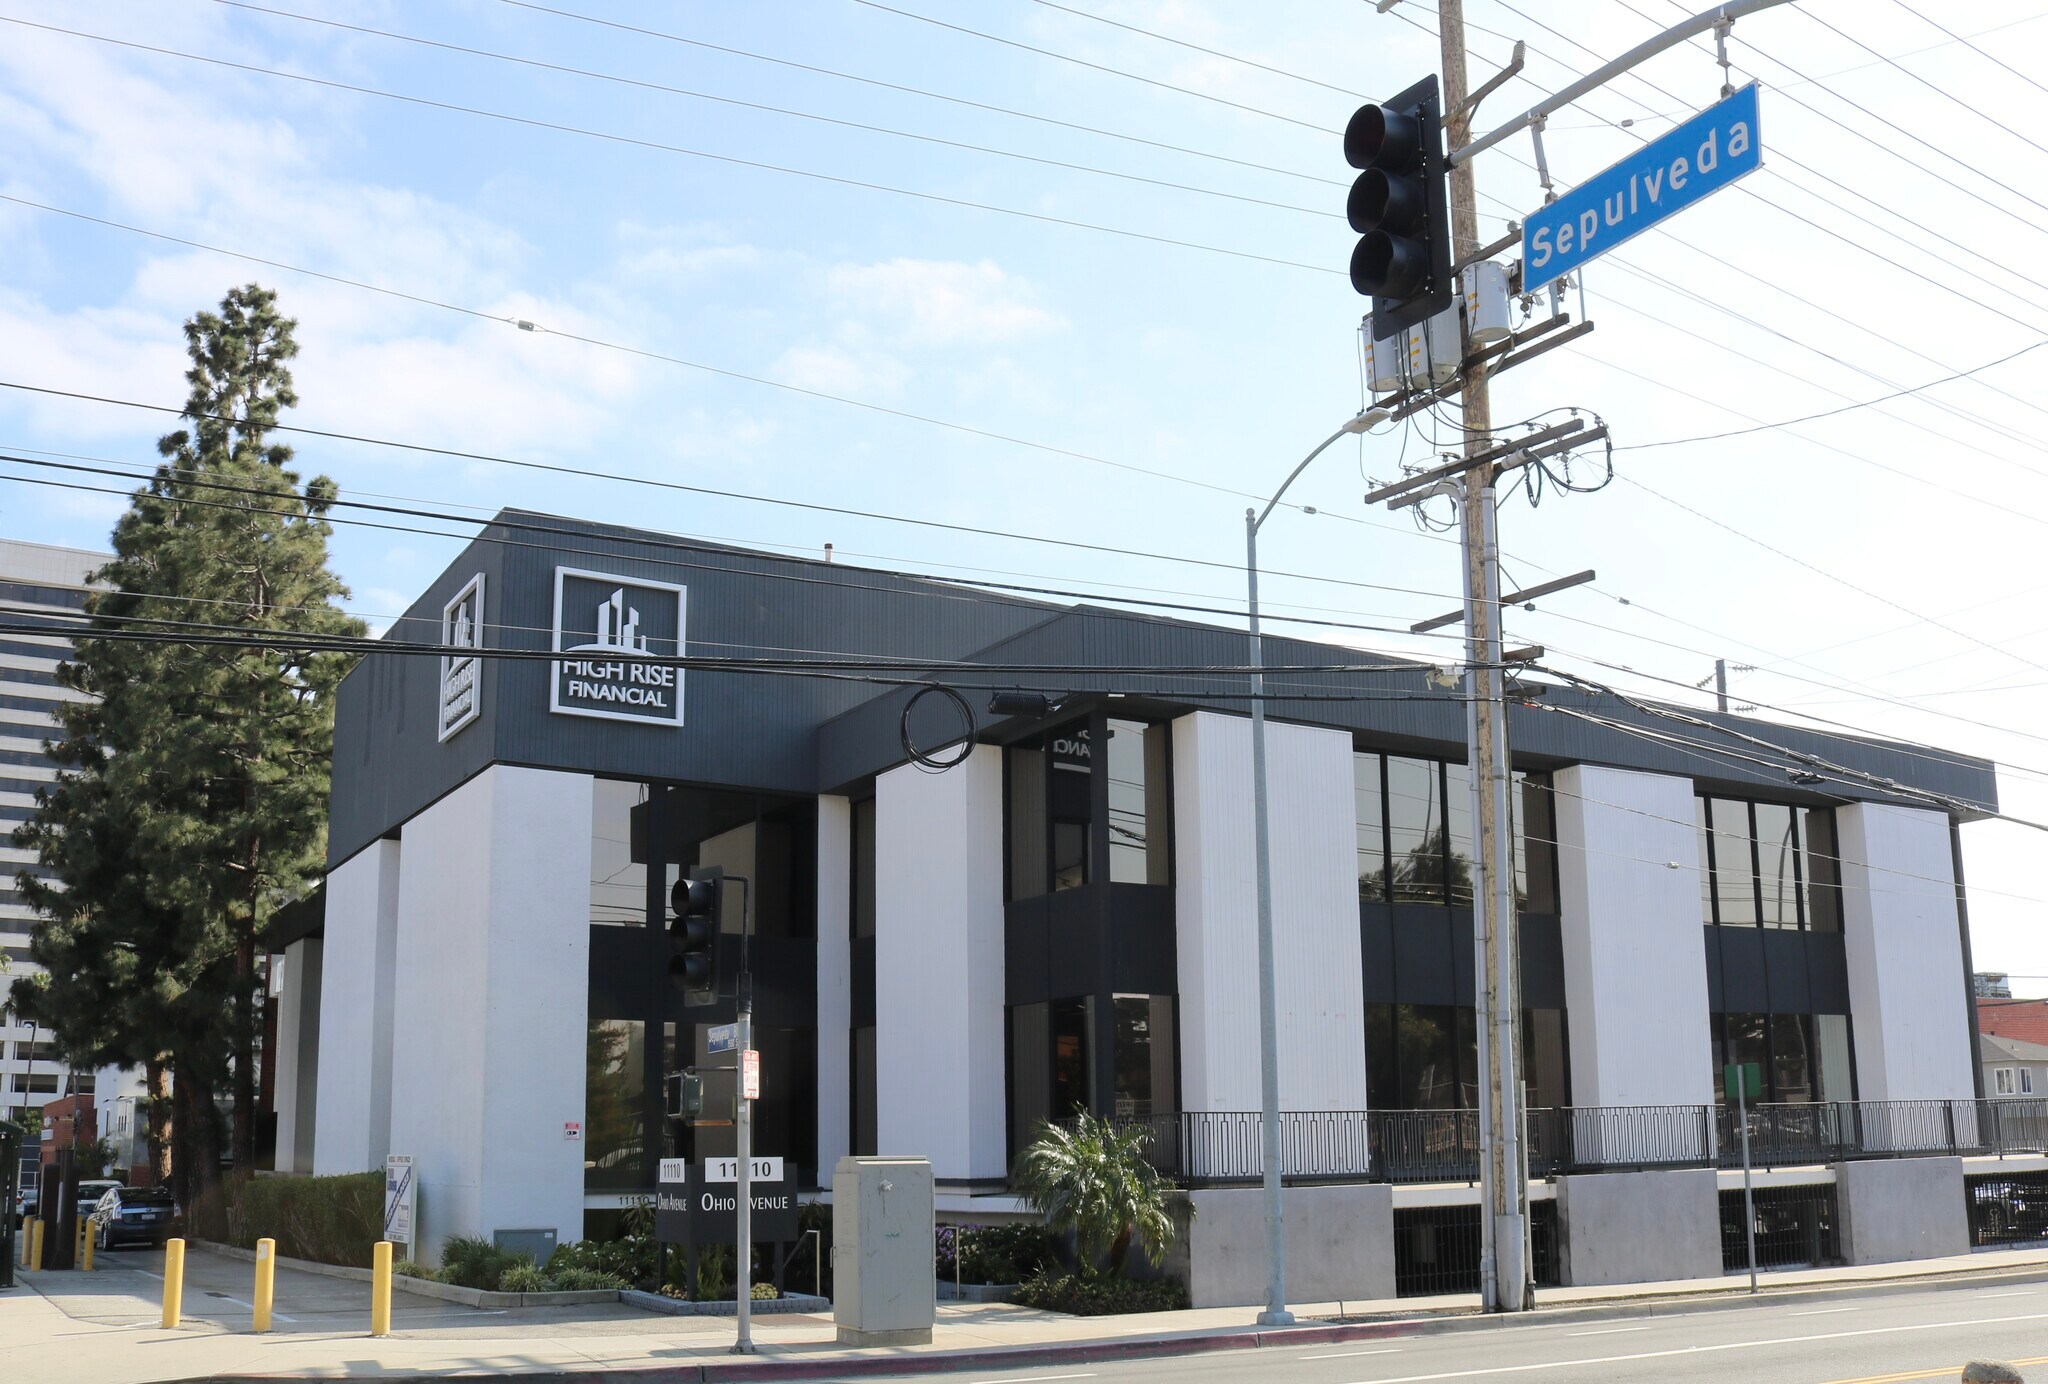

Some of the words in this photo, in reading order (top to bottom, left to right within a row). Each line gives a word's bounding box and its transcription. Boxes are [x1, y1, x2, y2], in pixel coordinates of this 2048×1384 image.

[1531, 121, 1749, 269] Sepulveda
[563, 660, 624, 681] HIGH
[629, 663, 674, 687] RISE
[568, 680, 668, 708] FINANCIAL
[662, 1163, 681, 1179] 11110
[719, 1161, 771, 1178] 1110
[750, 1196, 788, 1210] VENUE
